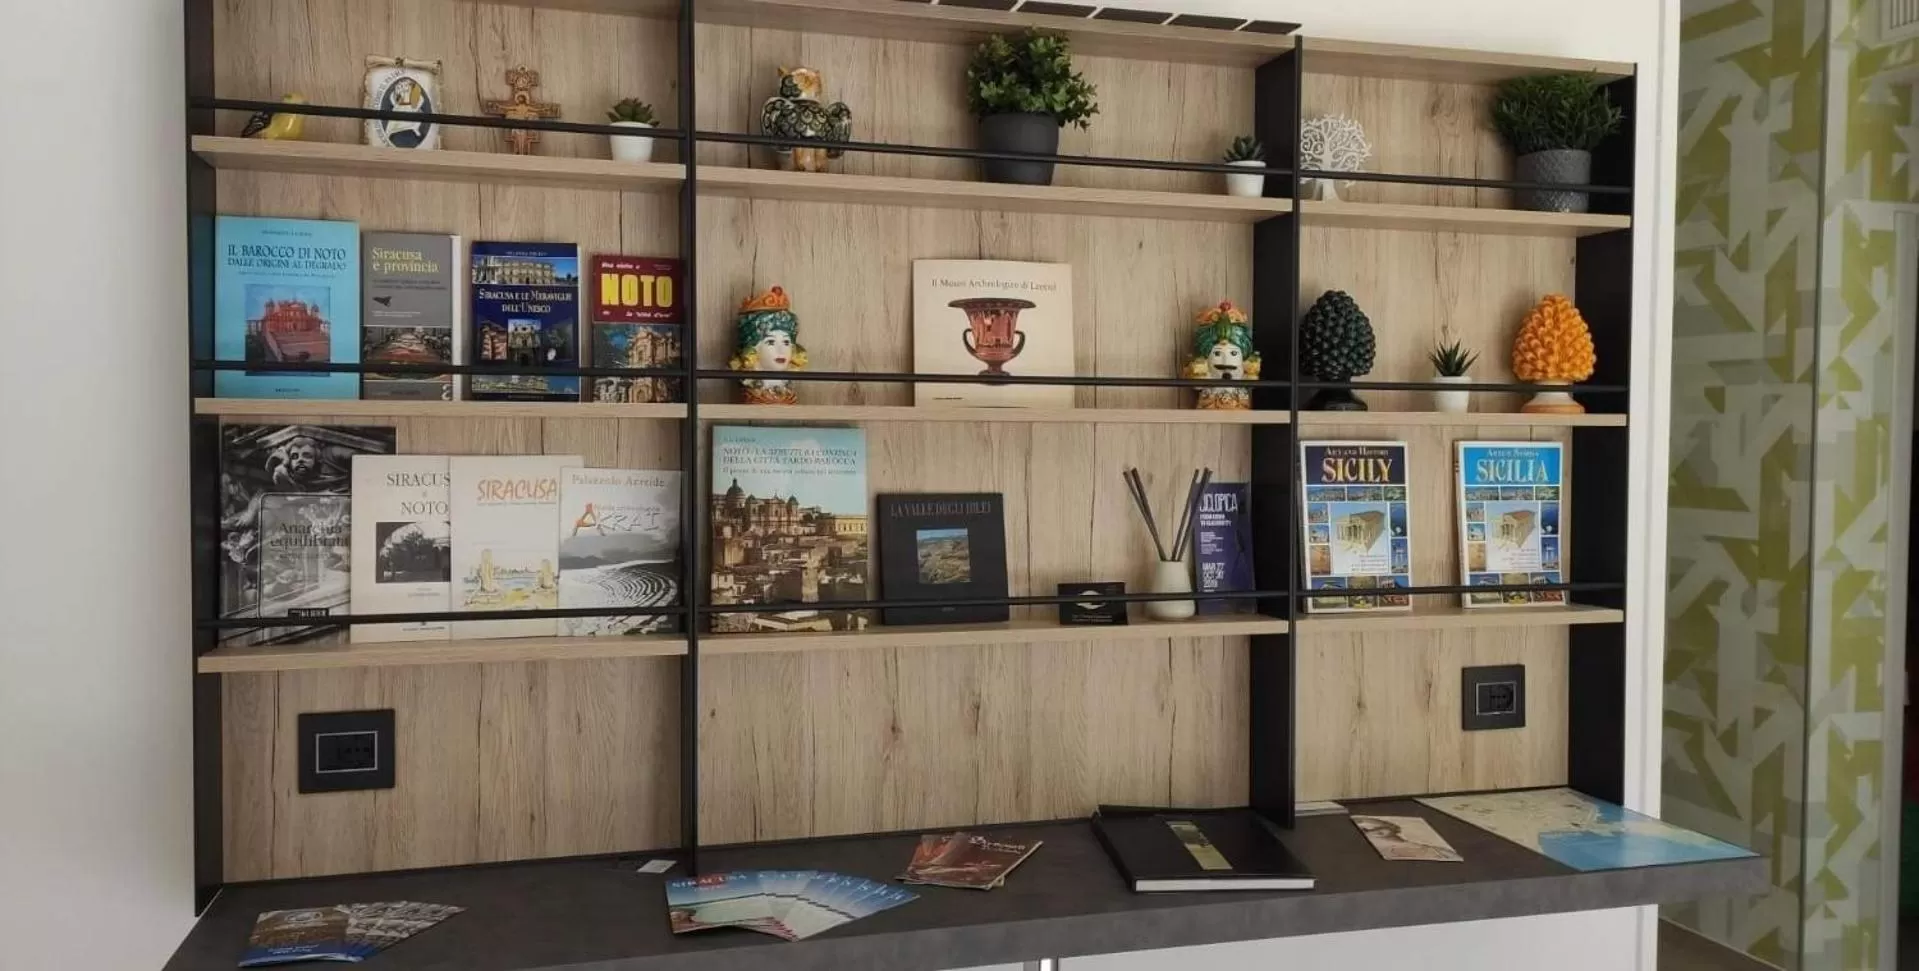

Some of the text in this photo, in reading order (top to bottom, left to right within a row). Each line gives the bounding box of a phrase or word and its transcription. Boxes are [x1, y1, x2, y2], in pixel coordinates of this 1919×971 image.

[228, 244, 346, 260] IL BAROCCO DI NOTO
[372, 246, 422, 260] Siracusa
[227, 257, 253, 268] DALLE
[372, 260, 441, 275] e provincia
[601, 273, 673, 308] NOTO
[1321, 457, 1393, 482] SICILY
[1475, 458, 1549, 482] SICILIA
[386, 472, 450, 487] SIRACUS
[477, 478, 558, 501] SIRACUSA
[401, 501, 449, 516] NOTO
